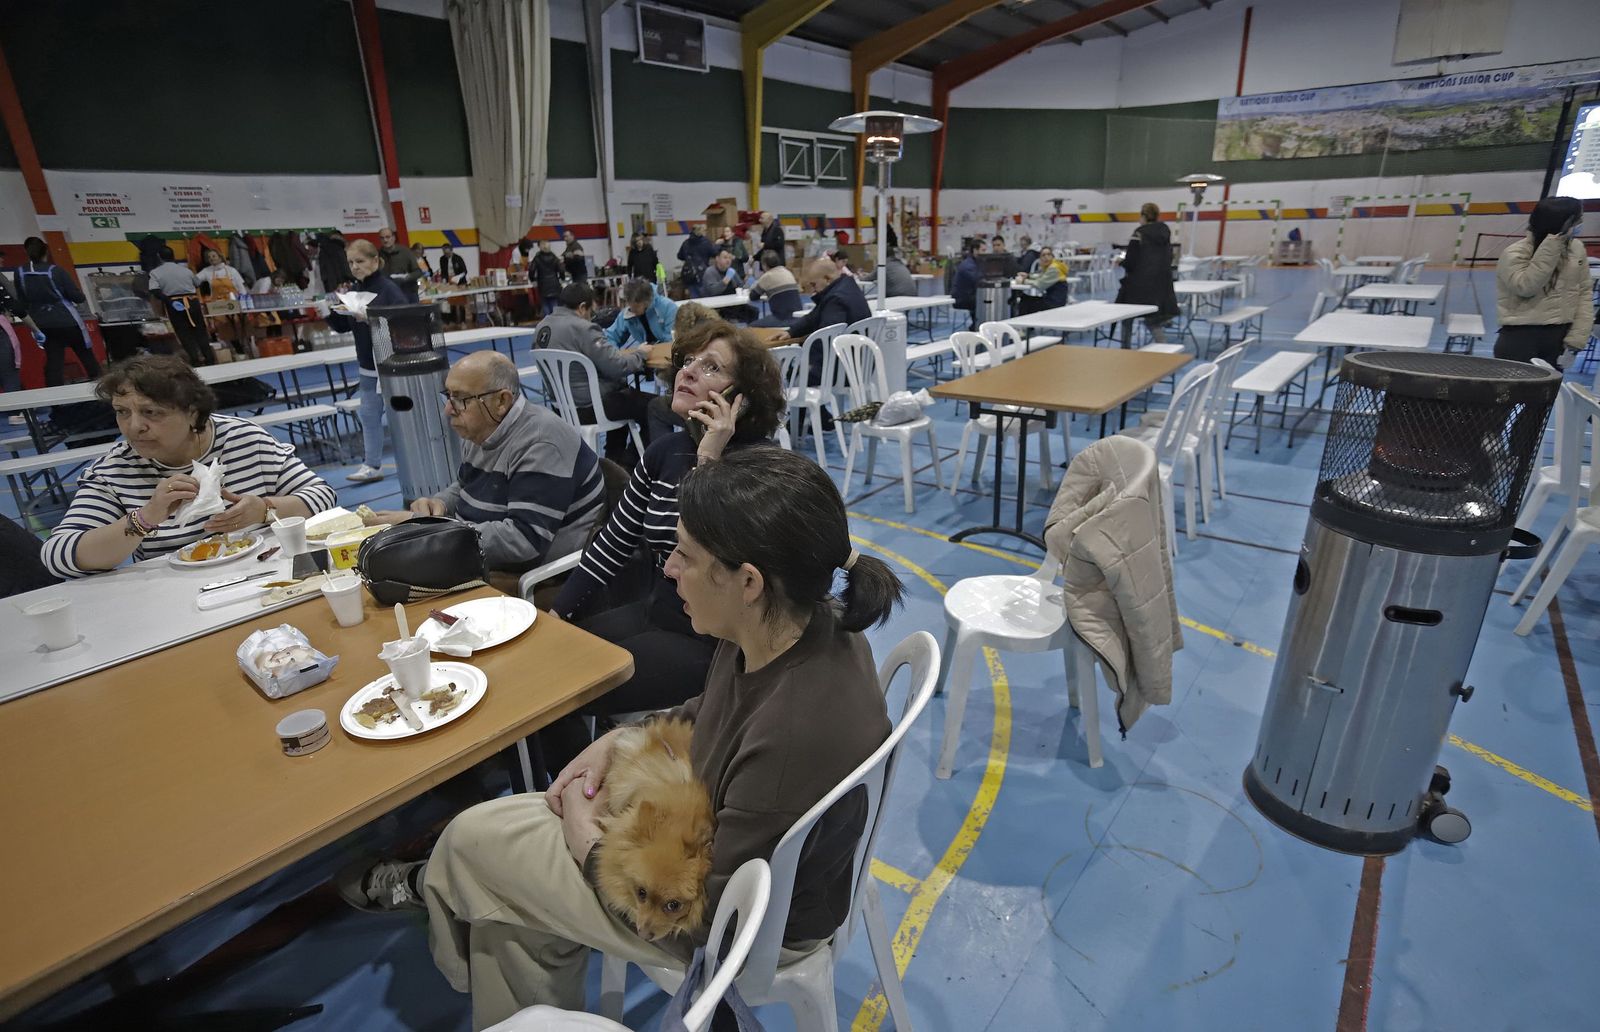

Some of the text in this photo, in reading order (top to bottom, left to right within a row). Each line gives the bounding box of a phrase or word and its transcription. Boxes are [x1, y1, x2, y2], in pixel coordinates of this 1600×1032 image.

[1458, 74, 1491, 86] SENIOR
[1493, 71, 1515, 82] CUP
[1298, 92, 1316, 101] CUP
